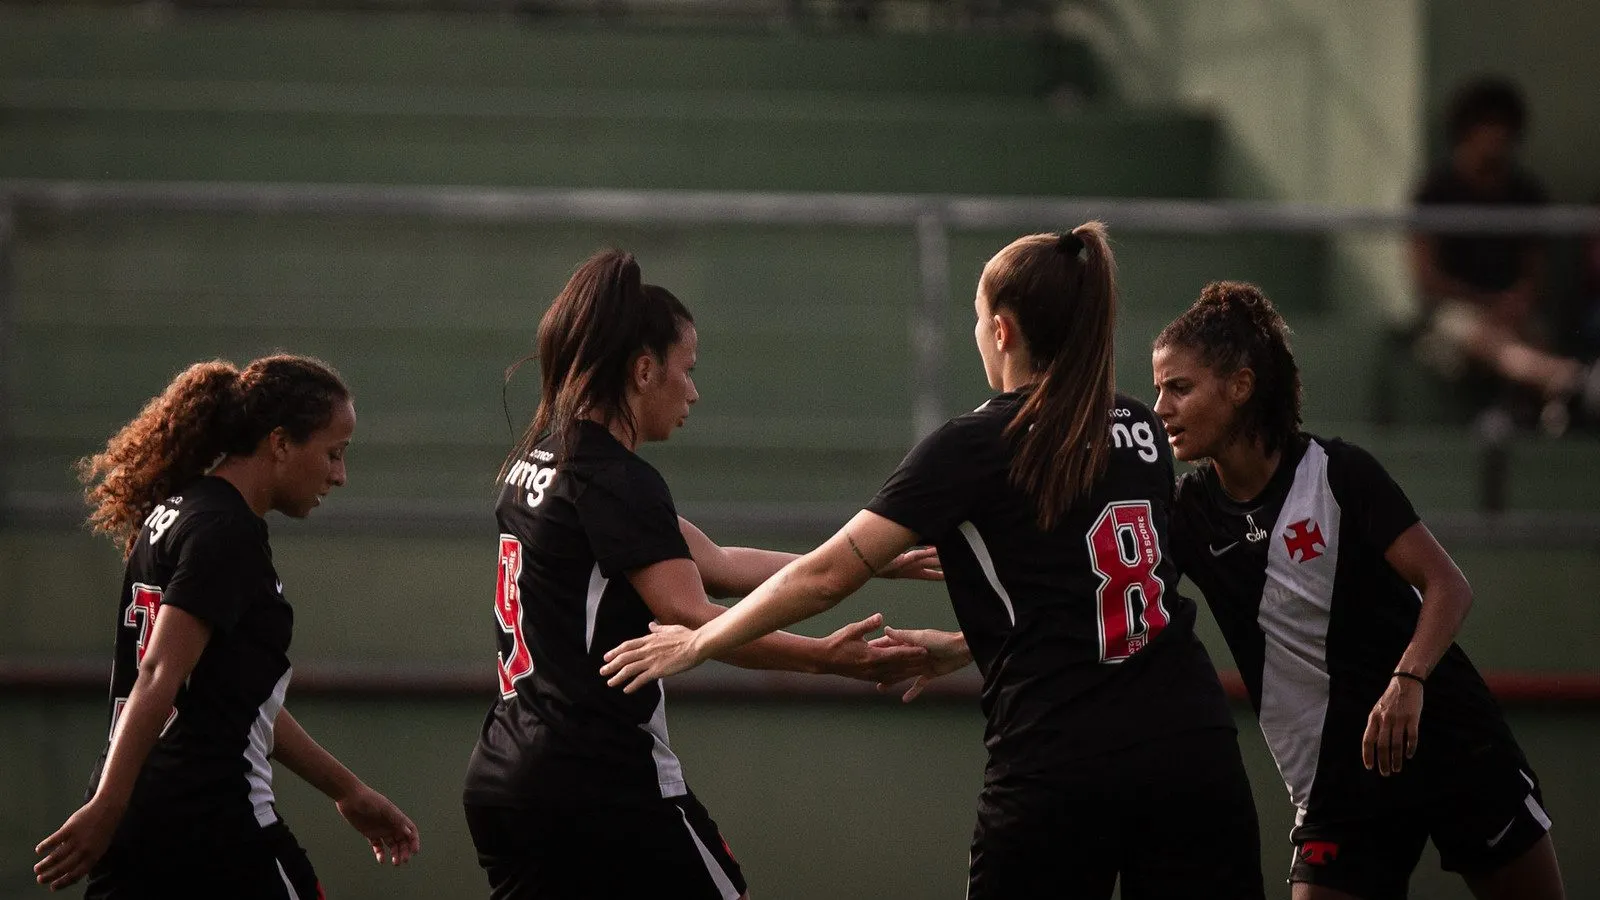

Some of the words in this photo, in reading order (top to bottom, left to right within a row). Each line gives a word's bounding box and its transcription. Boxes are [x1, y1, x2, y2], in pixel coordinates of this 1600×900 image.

[1086, 500, 1170, 664] 8
[1138, 516, 1151, 546] SCORE
[494, 533, 534, 700] 9
